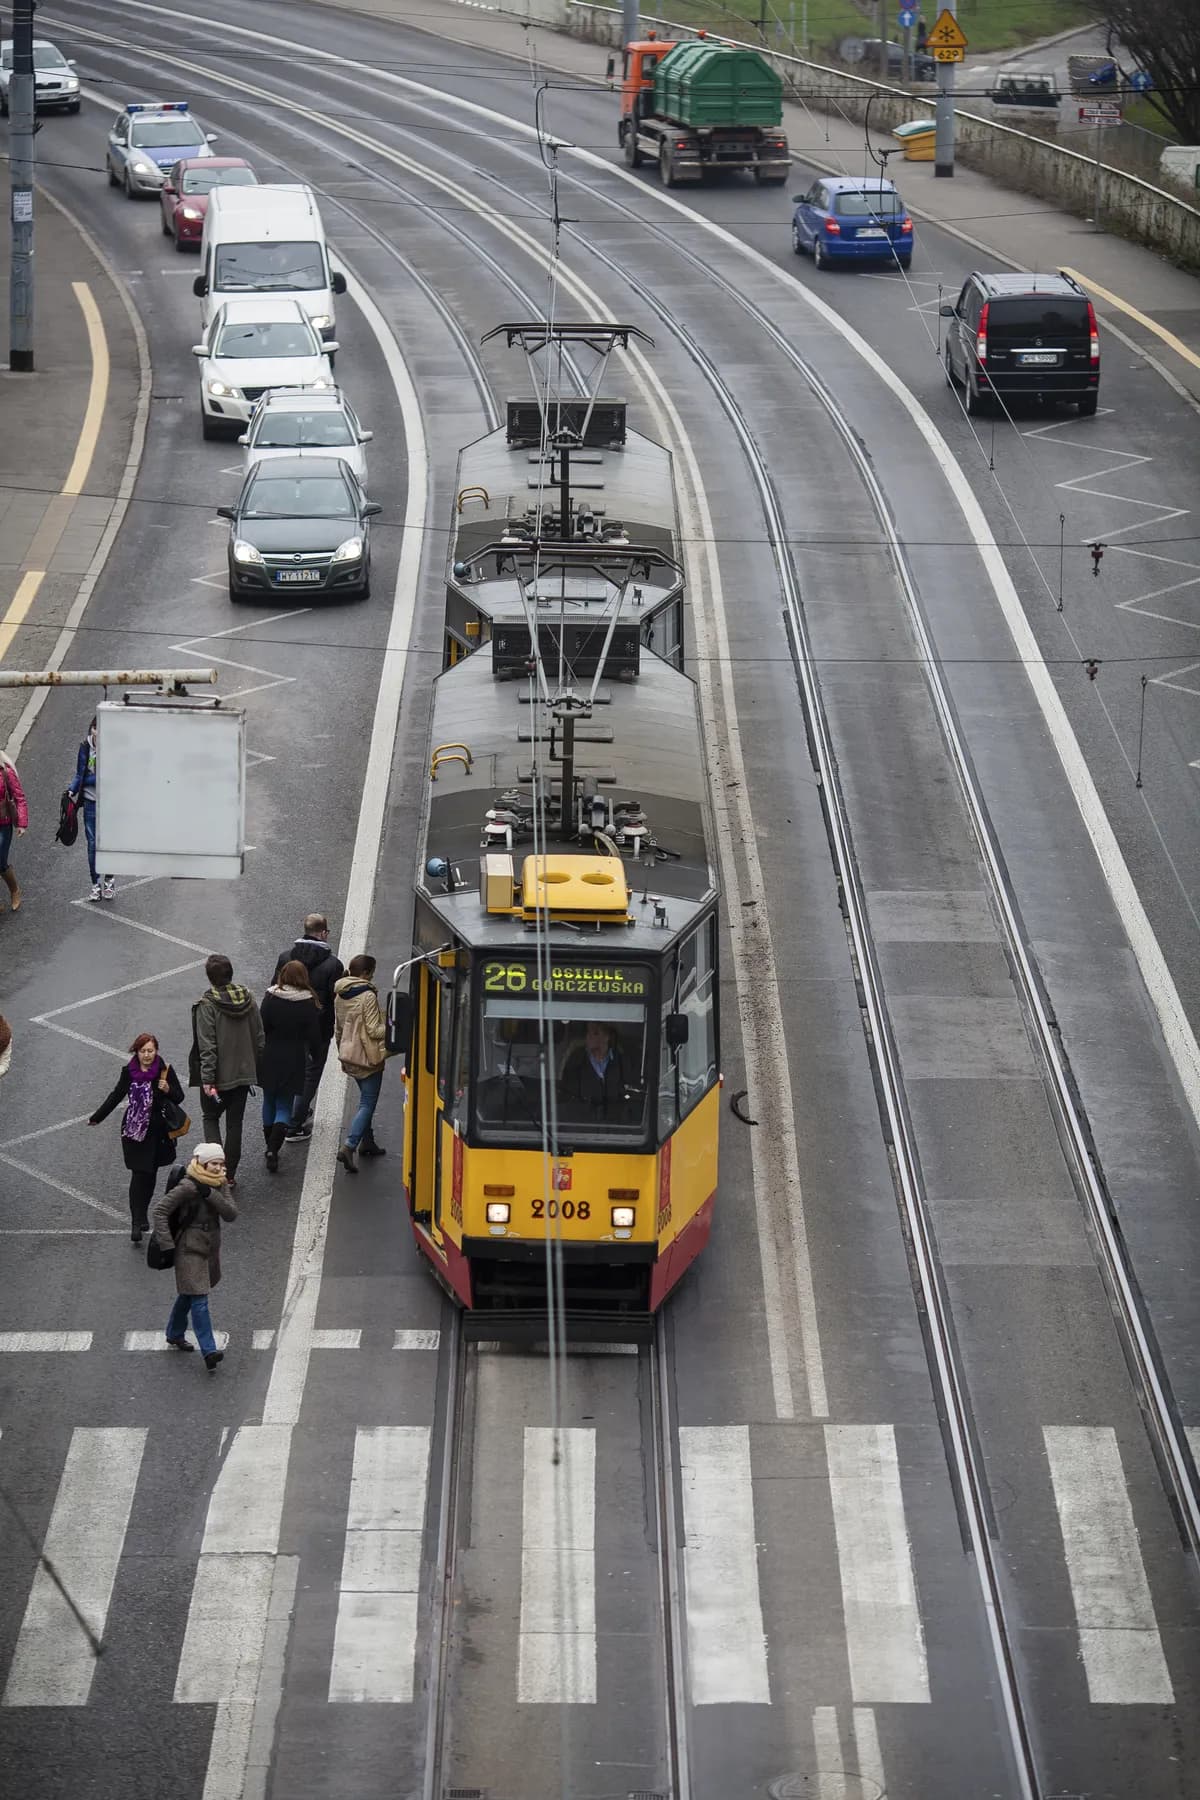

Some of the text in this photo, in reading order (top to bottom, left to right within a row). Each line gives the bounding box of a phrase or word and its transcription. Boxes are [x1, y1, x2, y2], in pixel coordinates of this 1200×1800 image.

[938, 49, 960, 60] 629
[484, 962, 527, 991] 26
[552, 967, 624, 980] OSIEDLE
[531, 1199, 591, 1220] 2008
